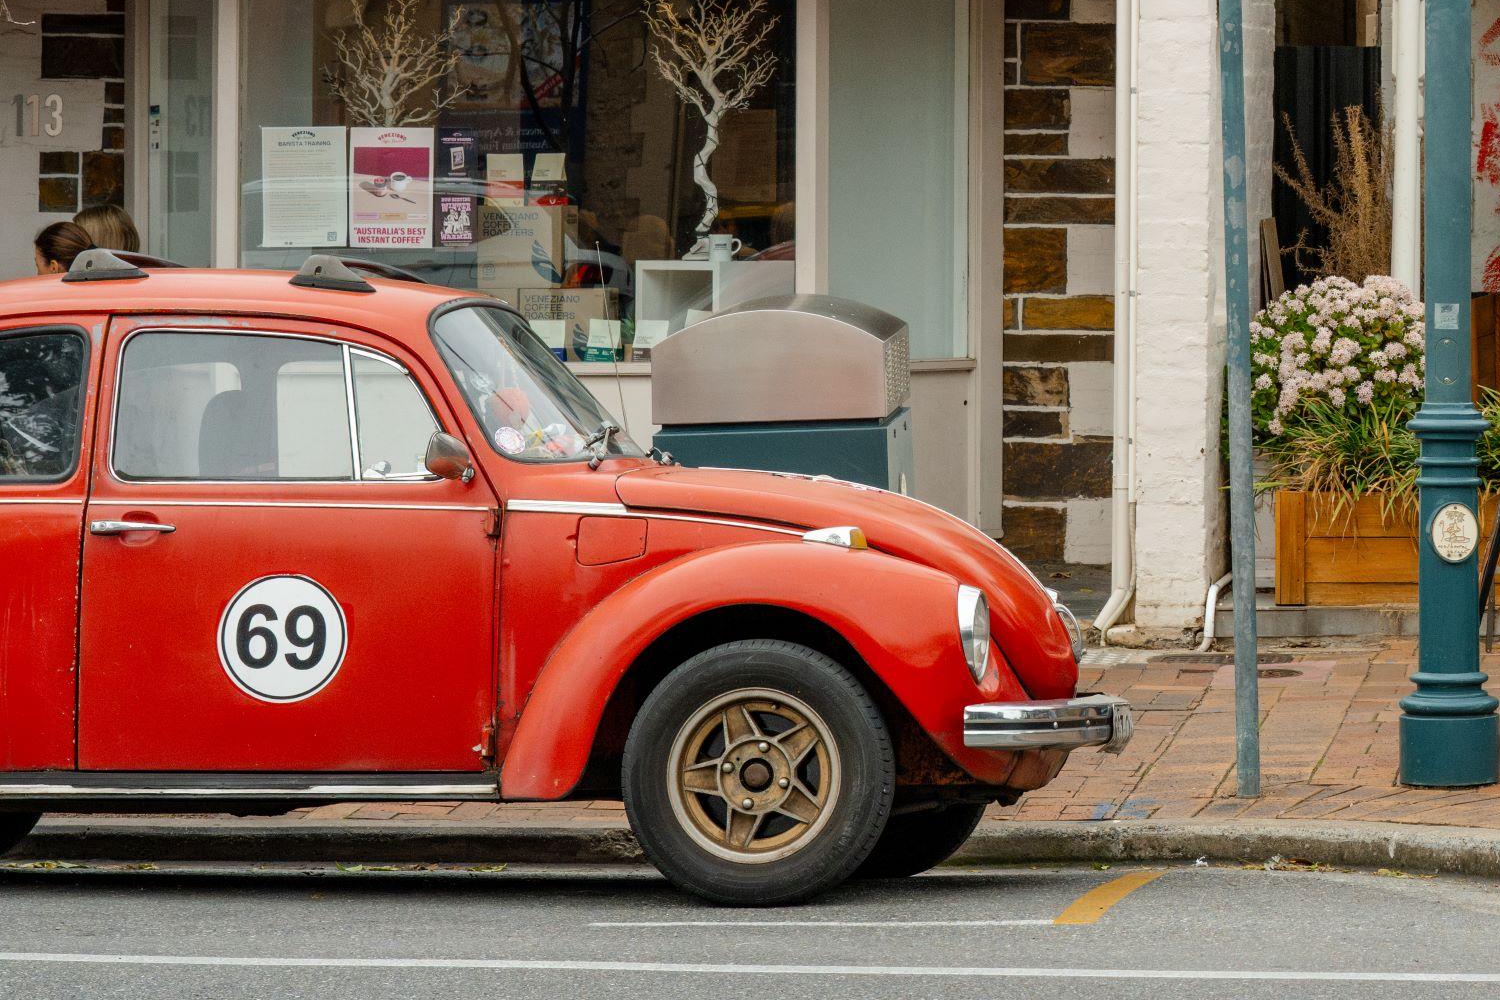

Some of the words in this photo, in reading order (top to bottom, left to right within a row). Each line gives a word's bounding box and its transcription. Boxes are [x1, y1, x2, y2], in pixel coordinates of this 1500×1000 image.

[10, 94, 63, 137] 113
[483, 212, 538, 220] VENEZIANO
[358, 236, 390, 244] INSTANT
[524, 295, 580, 303] VENEZIANO
[524, 312, 576, 320] ROASTERS
[236, 604, 326, 670] 69
